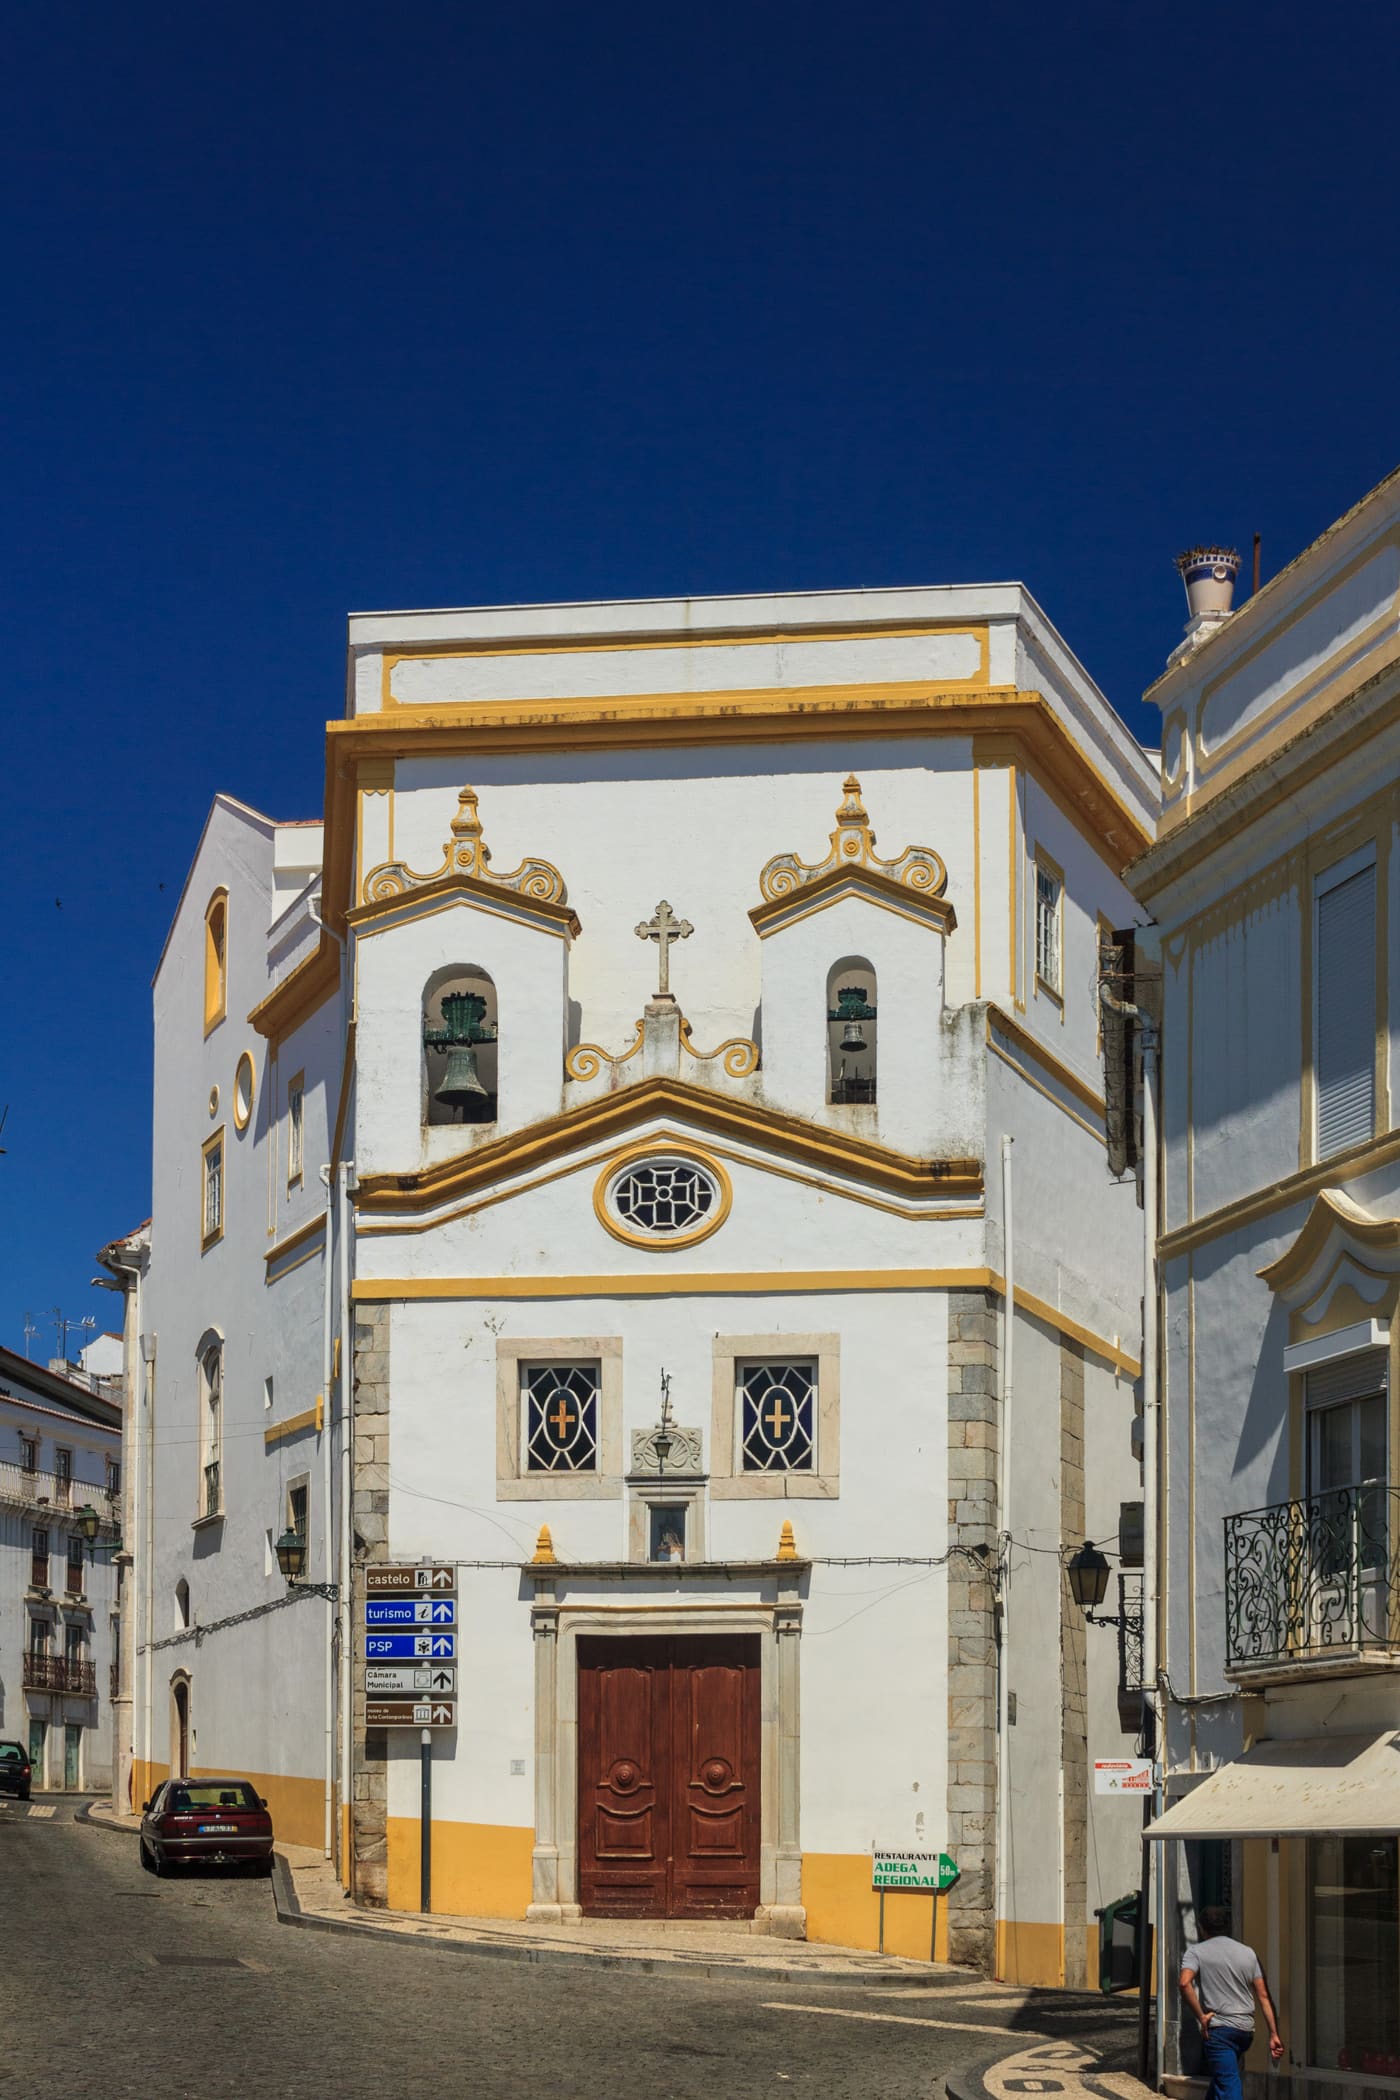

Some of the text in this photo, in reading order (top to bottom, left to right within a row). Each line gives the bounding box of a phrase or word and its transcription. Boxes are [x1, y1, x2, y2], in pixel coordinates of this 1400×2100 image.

[368, 1574, 410, 1584] castelo
[368, 1608, 412, 1619] turismo
[368, 1641, 393, 1652] PSP
[367, 1681, 404, 1690] Municipal
[874, 1852, 938, 1861] RESTAURANTE
[874, 1862, 918, 1873] ADEGA
[874, 1875, 937, 1886] REGIONAL
